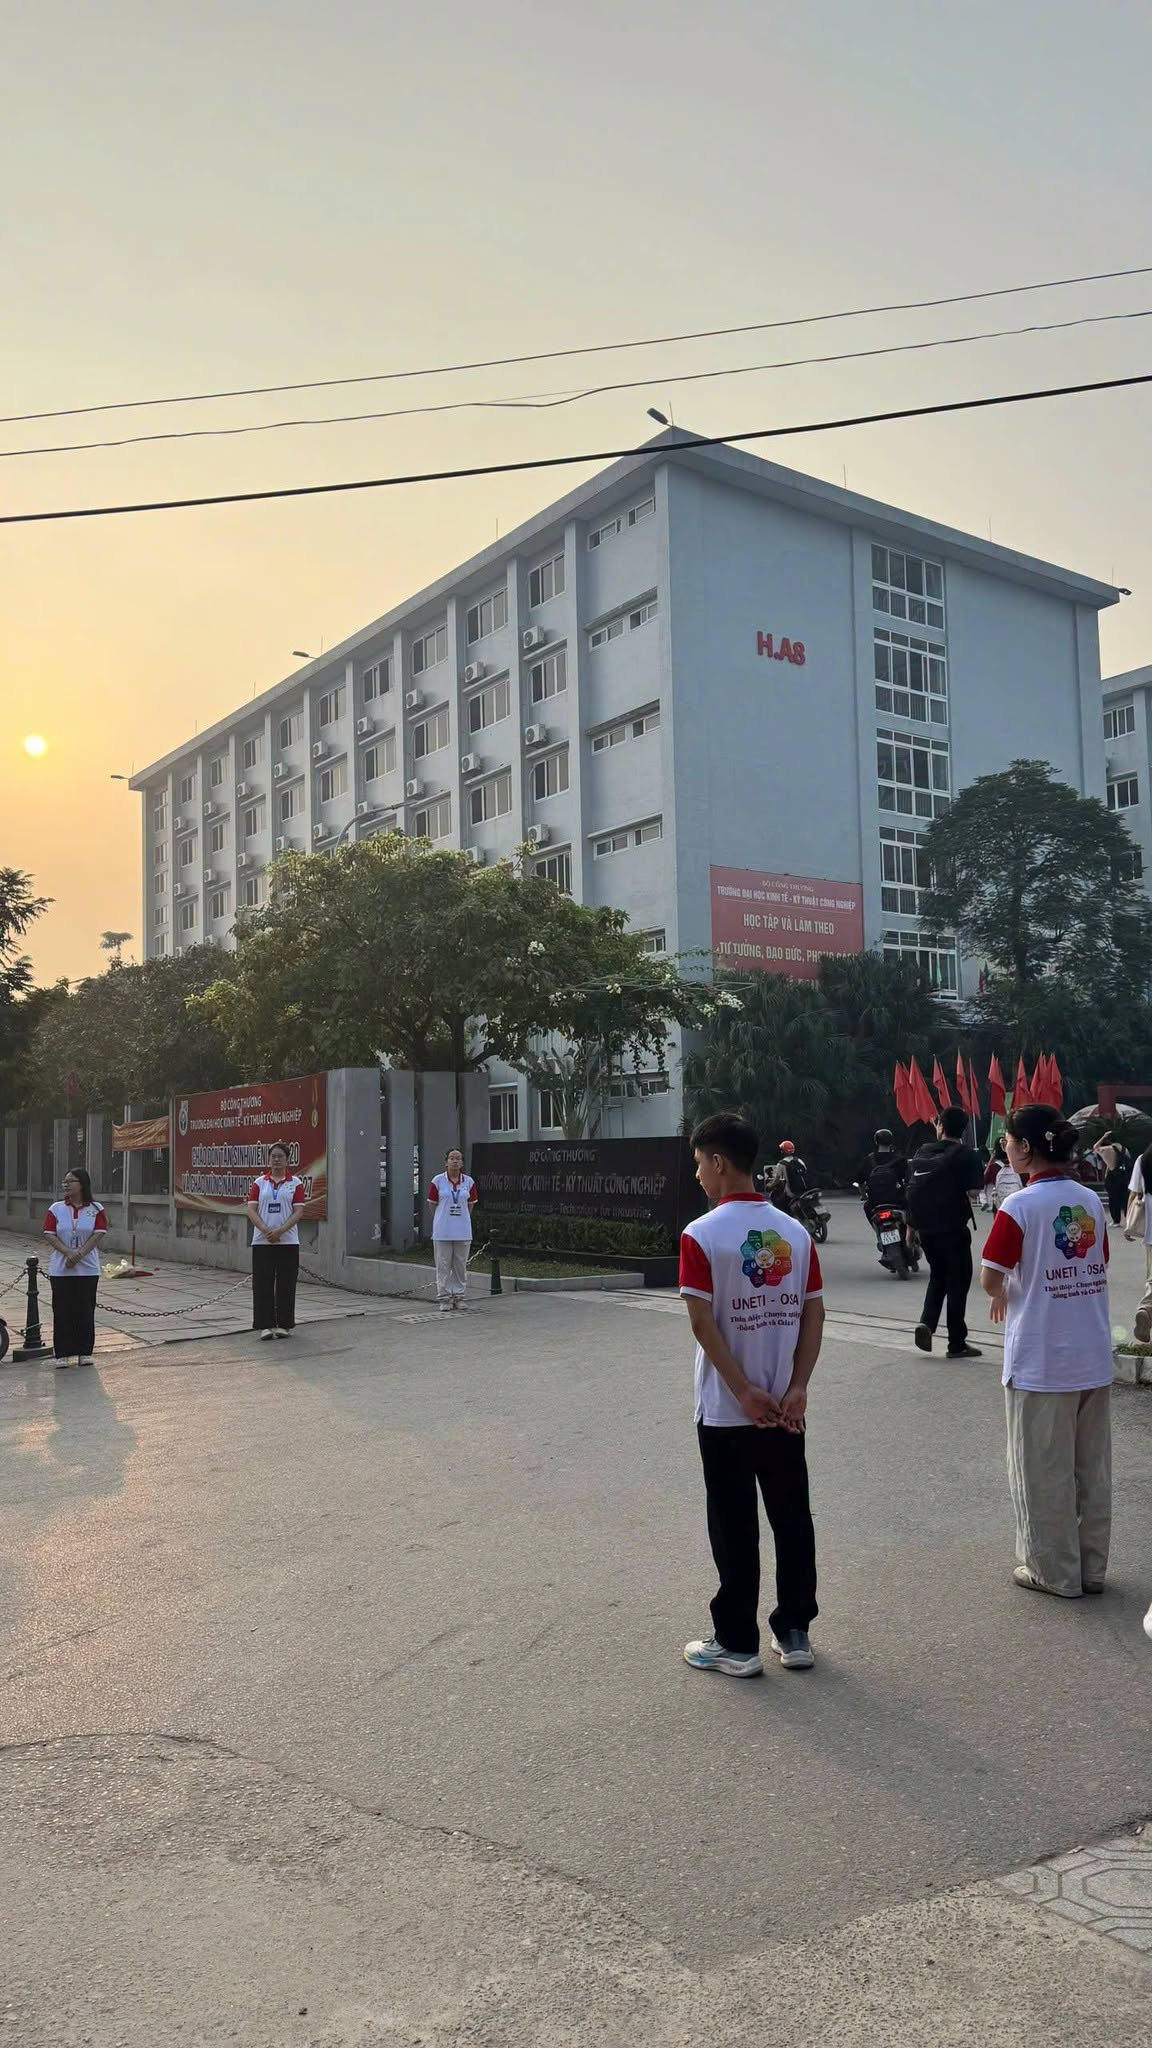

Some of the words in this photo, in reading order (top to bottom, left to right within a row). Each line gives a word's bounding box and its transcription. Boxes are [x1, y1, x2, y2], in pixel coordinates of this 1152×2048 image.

[757, 630, 806, 665] H.A8
[753, 890, 765, 901] HỌC
[766, 891, 781, 901] KINH
[781, 891, 789, 903] TẾ
[819, 896, 835, 908] CÔNG
[744, 913, 761, 930] HỌC
[763, 914, 779, 931] TẬP
[781, 915, 792, 931] VÀ
[794, 917, 812, 933] LÀM
[814, 921, 834, 935] THEO
[719, 942, 732, 954] TƯ
[733, 938, 764, 959] TƯỞNG,
[766, 946, 783, 962] ĐẠO
[785, 945, 805, 963] ĐỨC,
[806, 950, 834, 963] PHOG
[233, 1145, 249, 1168] SINH
[249, 1140, 267, 1167] VIÊN
[529, 1150, 540, 1166] BỘ
[540, 1148, 561, 1162] CNG
[562, 1148, 596, 1162] THƯƠNG
[552, 1170, 561, 1192] TẾ
[577, 1171, 604, 1198] THUẬT
[604, 1172, 630, 1194] CÔNG
[630, 1172, 666, 1200] NGHIỆP
[1046, 1266, 1077, 1280] UNETI
[1087, 1264, 1105, 1275] OSA
[732, 1295, 766, 1310] UNETI
[780, 1293, 799, 1305] OSA
